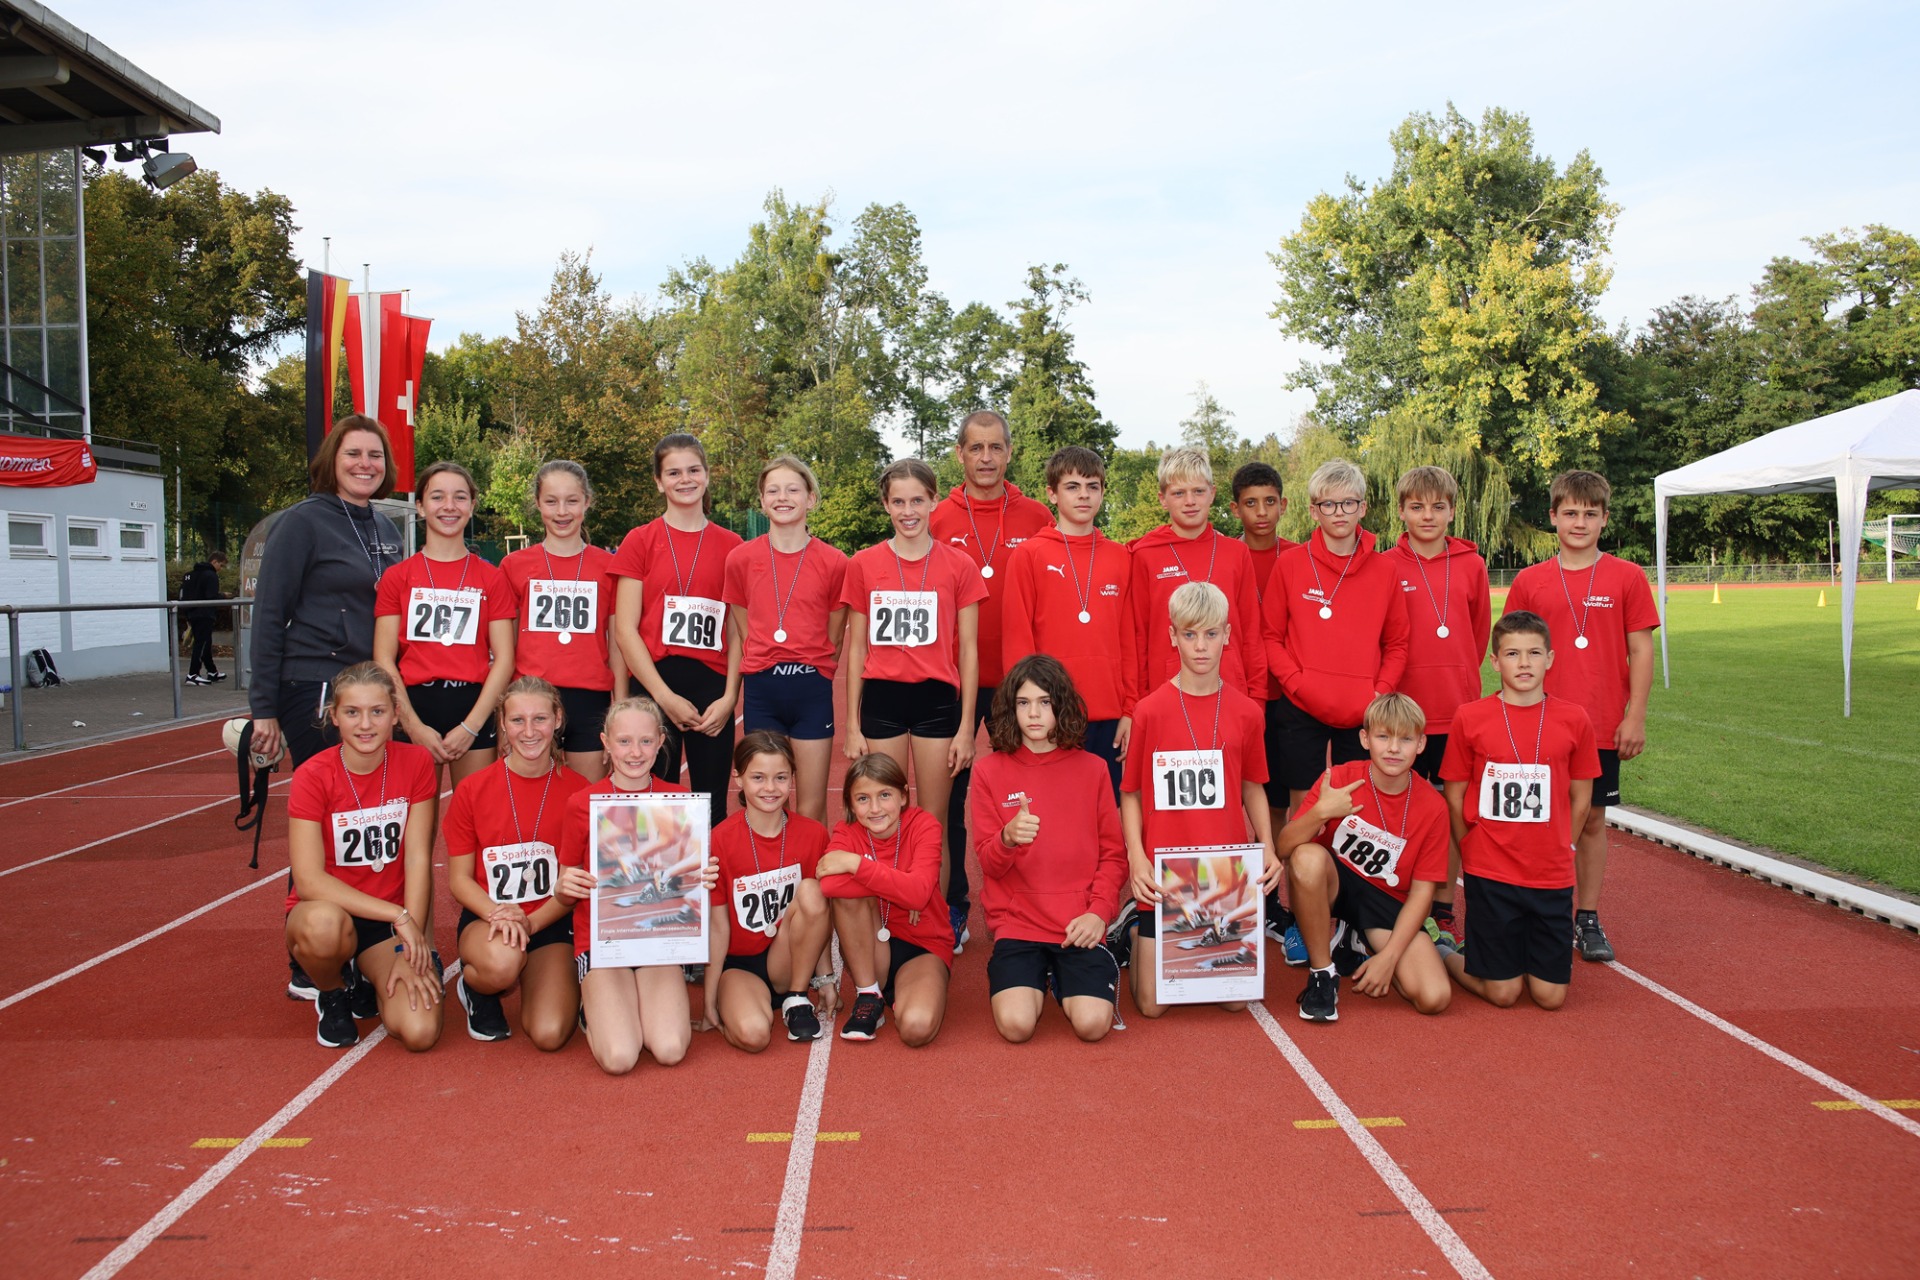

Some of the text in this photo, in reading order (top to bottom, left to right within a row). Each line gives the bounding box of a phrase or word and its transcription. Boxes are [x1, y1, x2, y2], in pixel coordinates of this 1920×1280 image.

[0, 456, 54, 472] ommen
[428, 592, 475, 605] Sparkasse
[547, 584, 593, 595] Sparkasse
[688, 603, 721, 615] arkasse
[886, 596, 933, 606] Sparkasse
[536, 594, 589, 630] 266
[414, 603, 472, 641] 267
[669, 611, 716, 648] 269
[876, 607, 929, 643] 263
[773, 664, 816, 676] NIKE
[1170, 757, 1219, 768] Sparkasse
[1496, 770, 1547, 781] Sparkasse
[1491, 782, 1543, 819] 184
[352, 811, 403, 826] Sparkasse
[343, 821, 401, 863] 268
[1358, 826, 1401, 852] Sparkasse
[501, 848, 552, 861] Sparkasse
[1339, 833, 1391, 876] 188
[492, 858, 551, 900] 270
[750, 872, 797, 891] Sparkasse
[742, 883, 795, 929] 264
